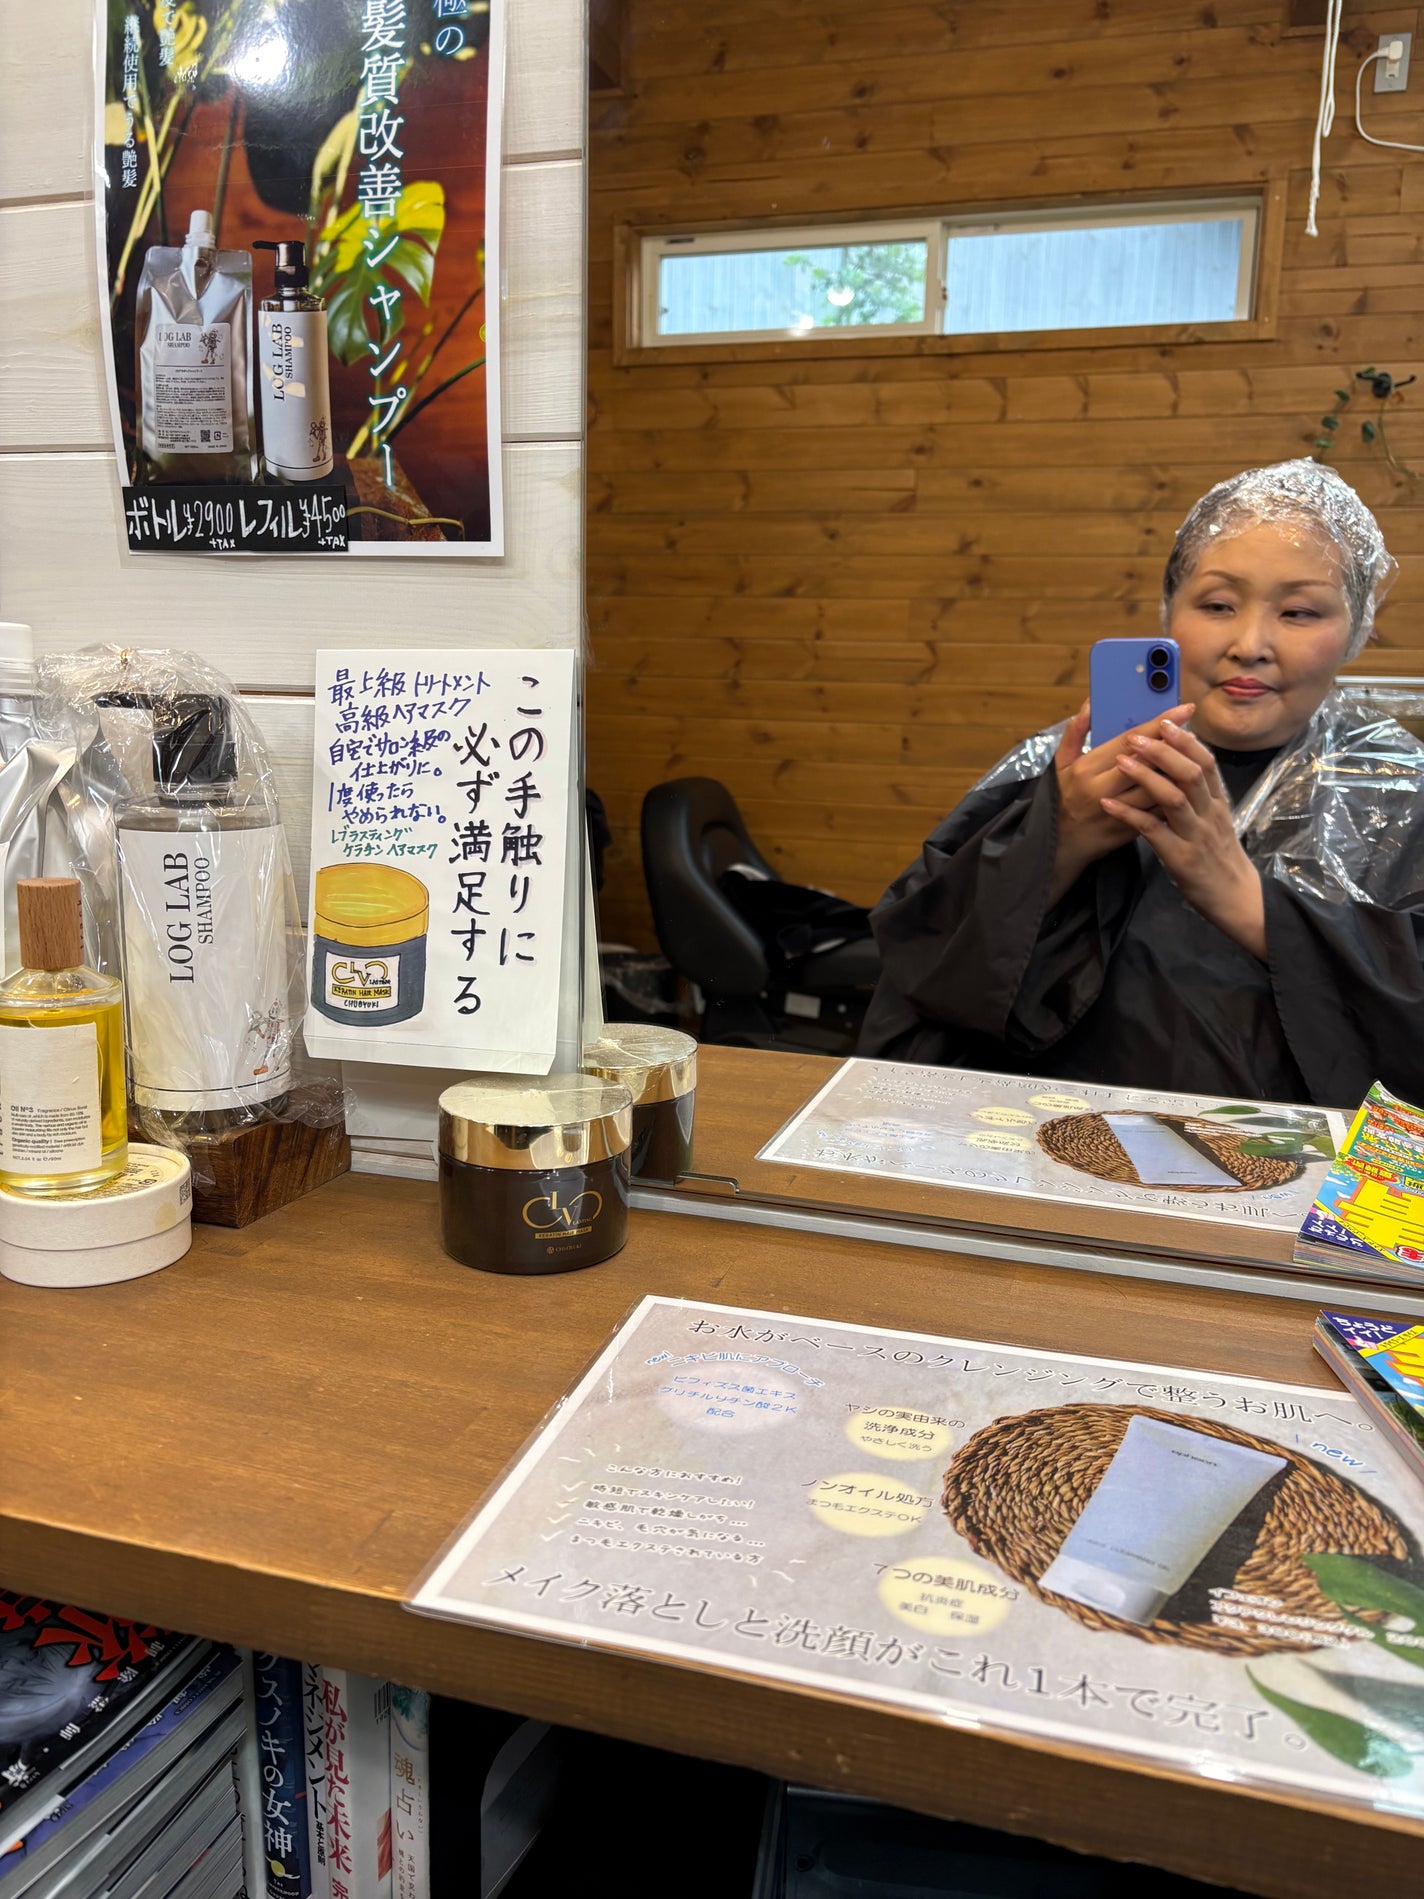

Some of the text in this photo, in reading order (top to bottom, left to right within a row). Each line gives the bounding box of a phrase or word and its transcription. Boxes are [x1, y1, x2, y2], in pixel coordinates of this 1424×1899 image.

[358, 0, 406, 488] 髪質改善シャンプー
[271, 323, 285, 401] LOG LAB
[283, 326, 293, 379] SHAMPOO
[328, 729, 451, 765] 自宅でサロン級の
[350, 757, 443, 782] 仕上がりに。
[342, 803, 447, 825] やめられない。
[500, 675, 545, 966] この手触りに
[448, 721, 501, 1015] 必ず満足する
[163, 852, 195, 983] LOG LAB
[193, 857, 214, 945] SHAMPOO
[688, 1319, 1375, 1433] お水がベースのクレンジングで整うお肌へ。
[706, 1407, 736, 1418] 配合
[845, 1403, 966, 1429] ヤシの実由来の
[864, 1421, 936, 1440] 洗浄成分
[861, 1435, 933, 1452] やさしく洗う
[1311, 1439, 1364, 1469] new
[801, 1479, 935, 1508] ノンオイル処方
[481, 1563, 1310, 1752] メイク落としと洗顔がこれ1本で完了。
[322, 1679, 352, 1874] 私が見た未来
